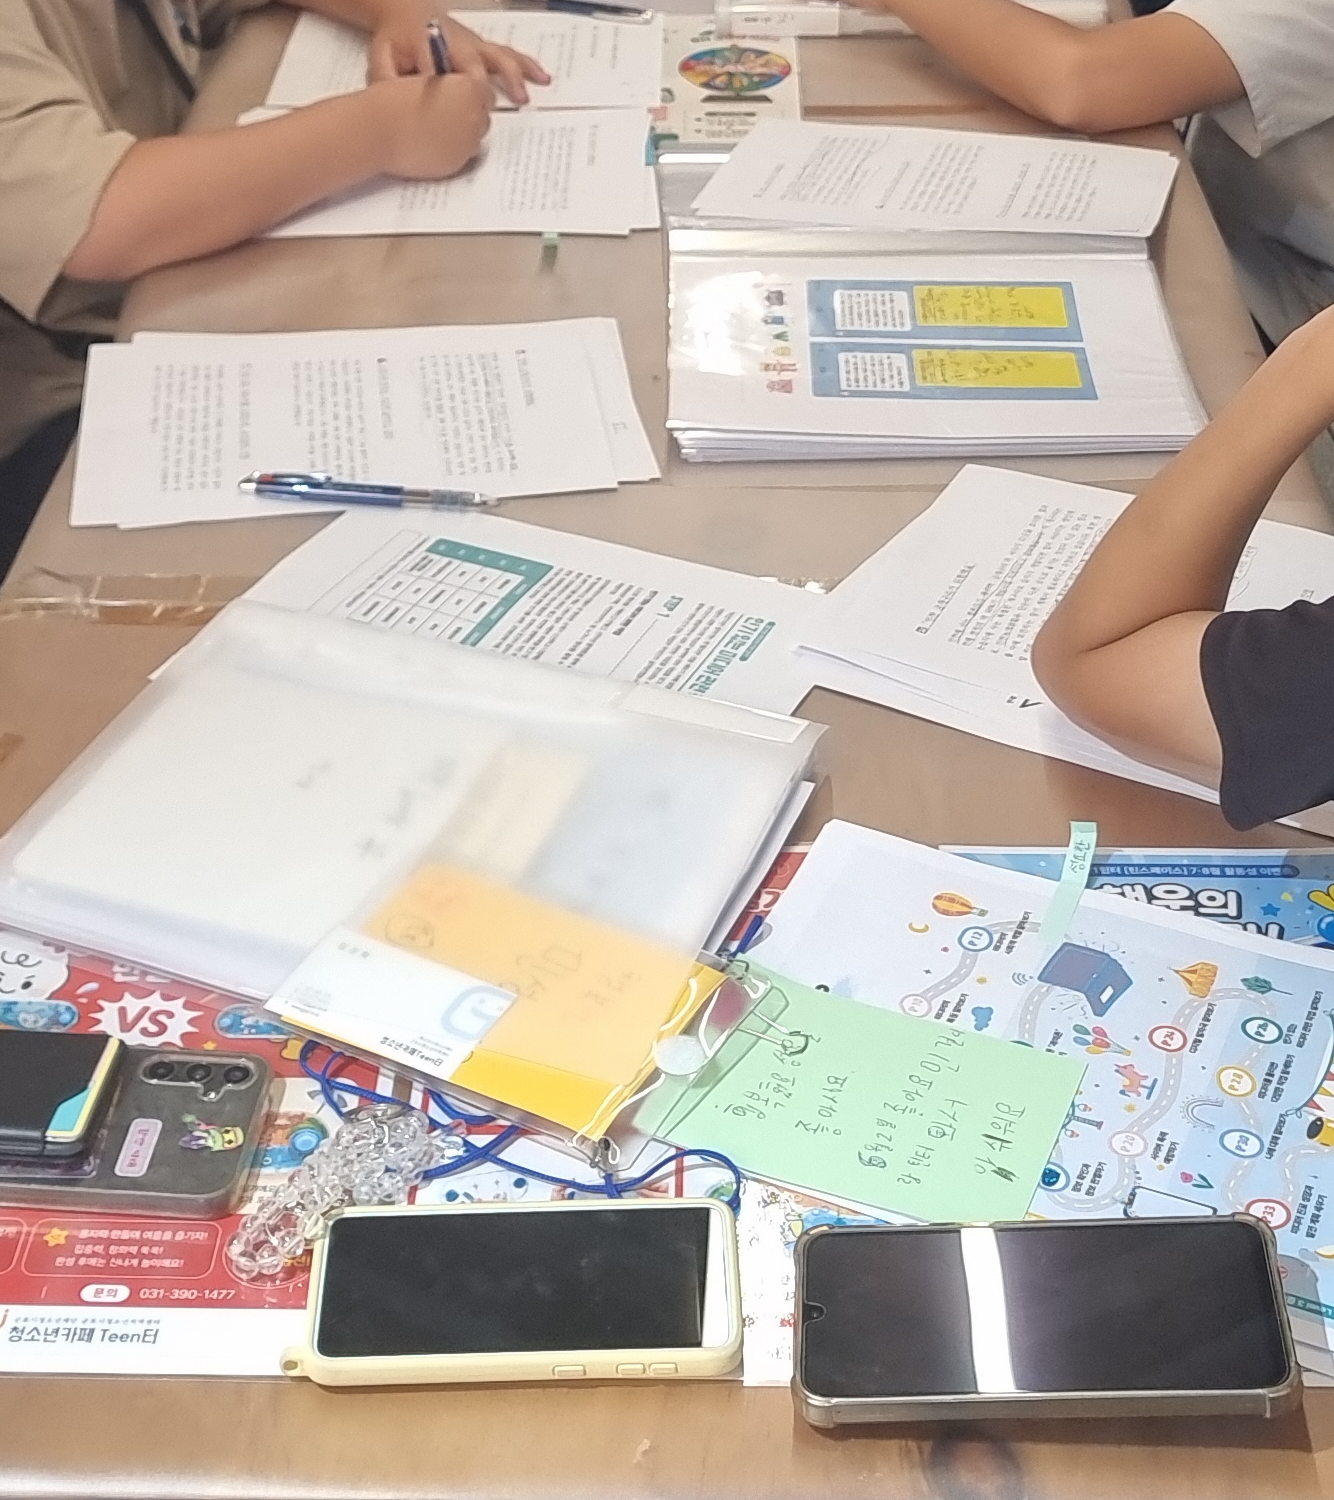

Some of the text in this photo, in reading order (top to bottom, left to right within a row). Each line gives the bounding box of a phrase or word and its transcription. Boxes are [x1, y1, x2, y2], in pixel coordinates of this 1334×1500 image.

[115, 1002, 176, 1040] VS
[93, 1286, 236, 1301] 문의 031-390-1477
[8, 1325, 160, 1345] 청소년카페 Teen터
